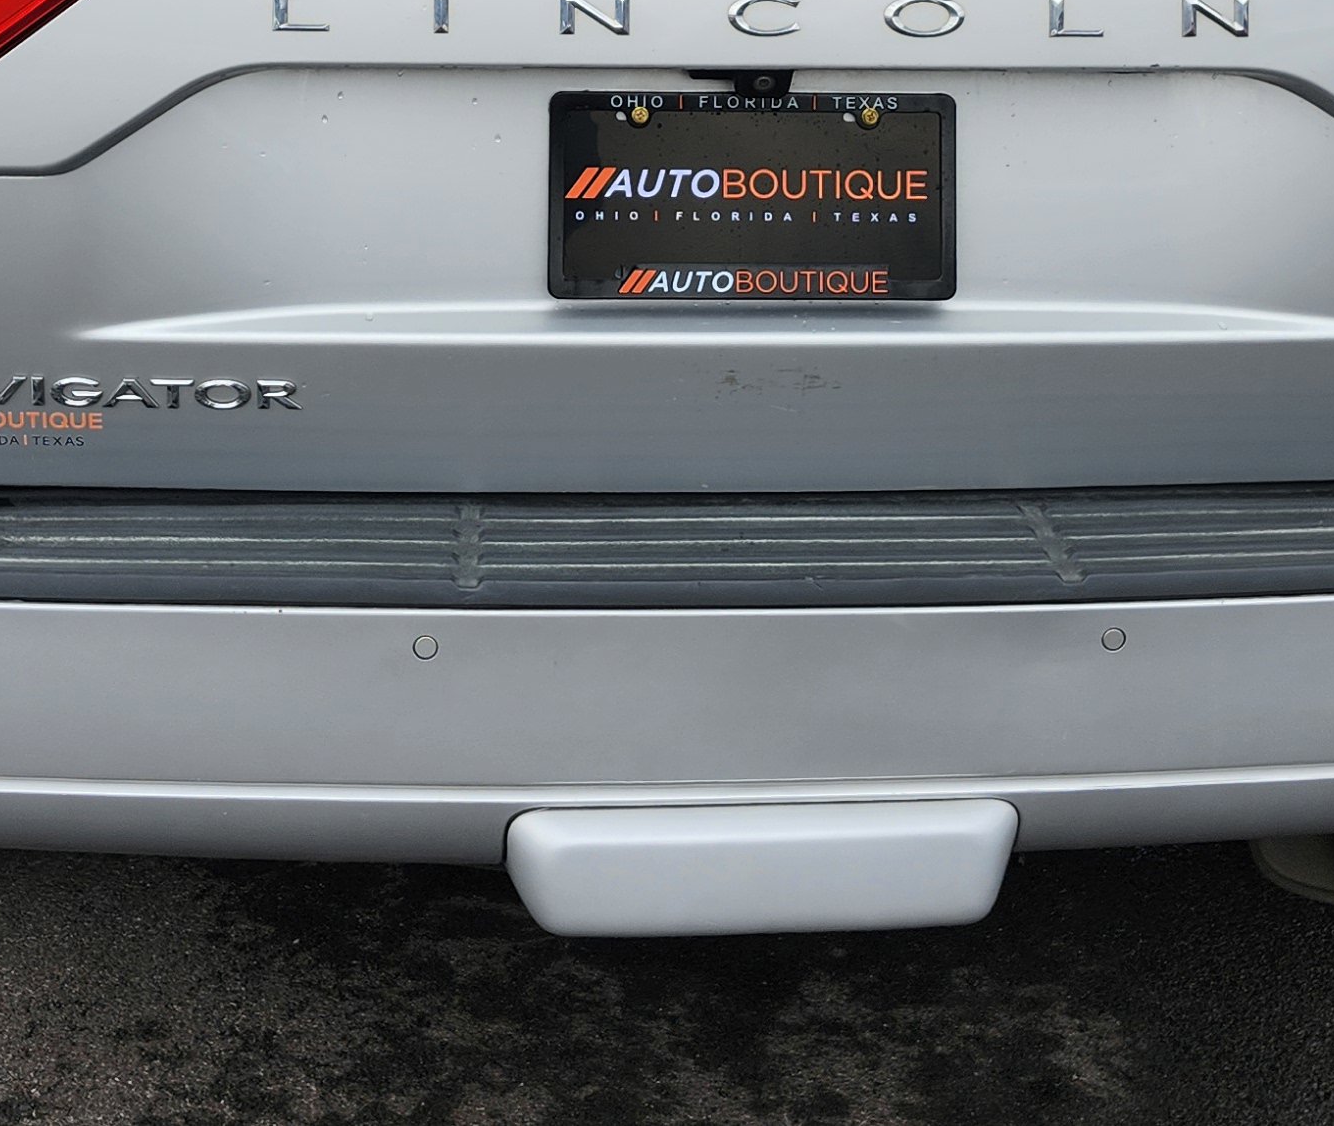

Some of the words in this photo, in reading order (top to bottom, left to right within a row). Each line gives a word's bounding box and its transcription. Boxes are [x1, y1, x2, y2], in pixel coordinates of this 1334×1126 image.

[610, 95, 664, 110] OHIO
[699, 95, 799, 110] FLORIDA
[833, 96, 898, 111] TEXAS
[605, 168, 928, 201] AUTOBOUTIQUE
[575, 210, 638, 221] OHIO
[675, 210, 792, 222] FLORIDA
[834, 211, 917, 223] TEXAS
[648, 270, 889, 294] AUTOBOUTIQUE
[33, 435, 85, 447] TEXAS
